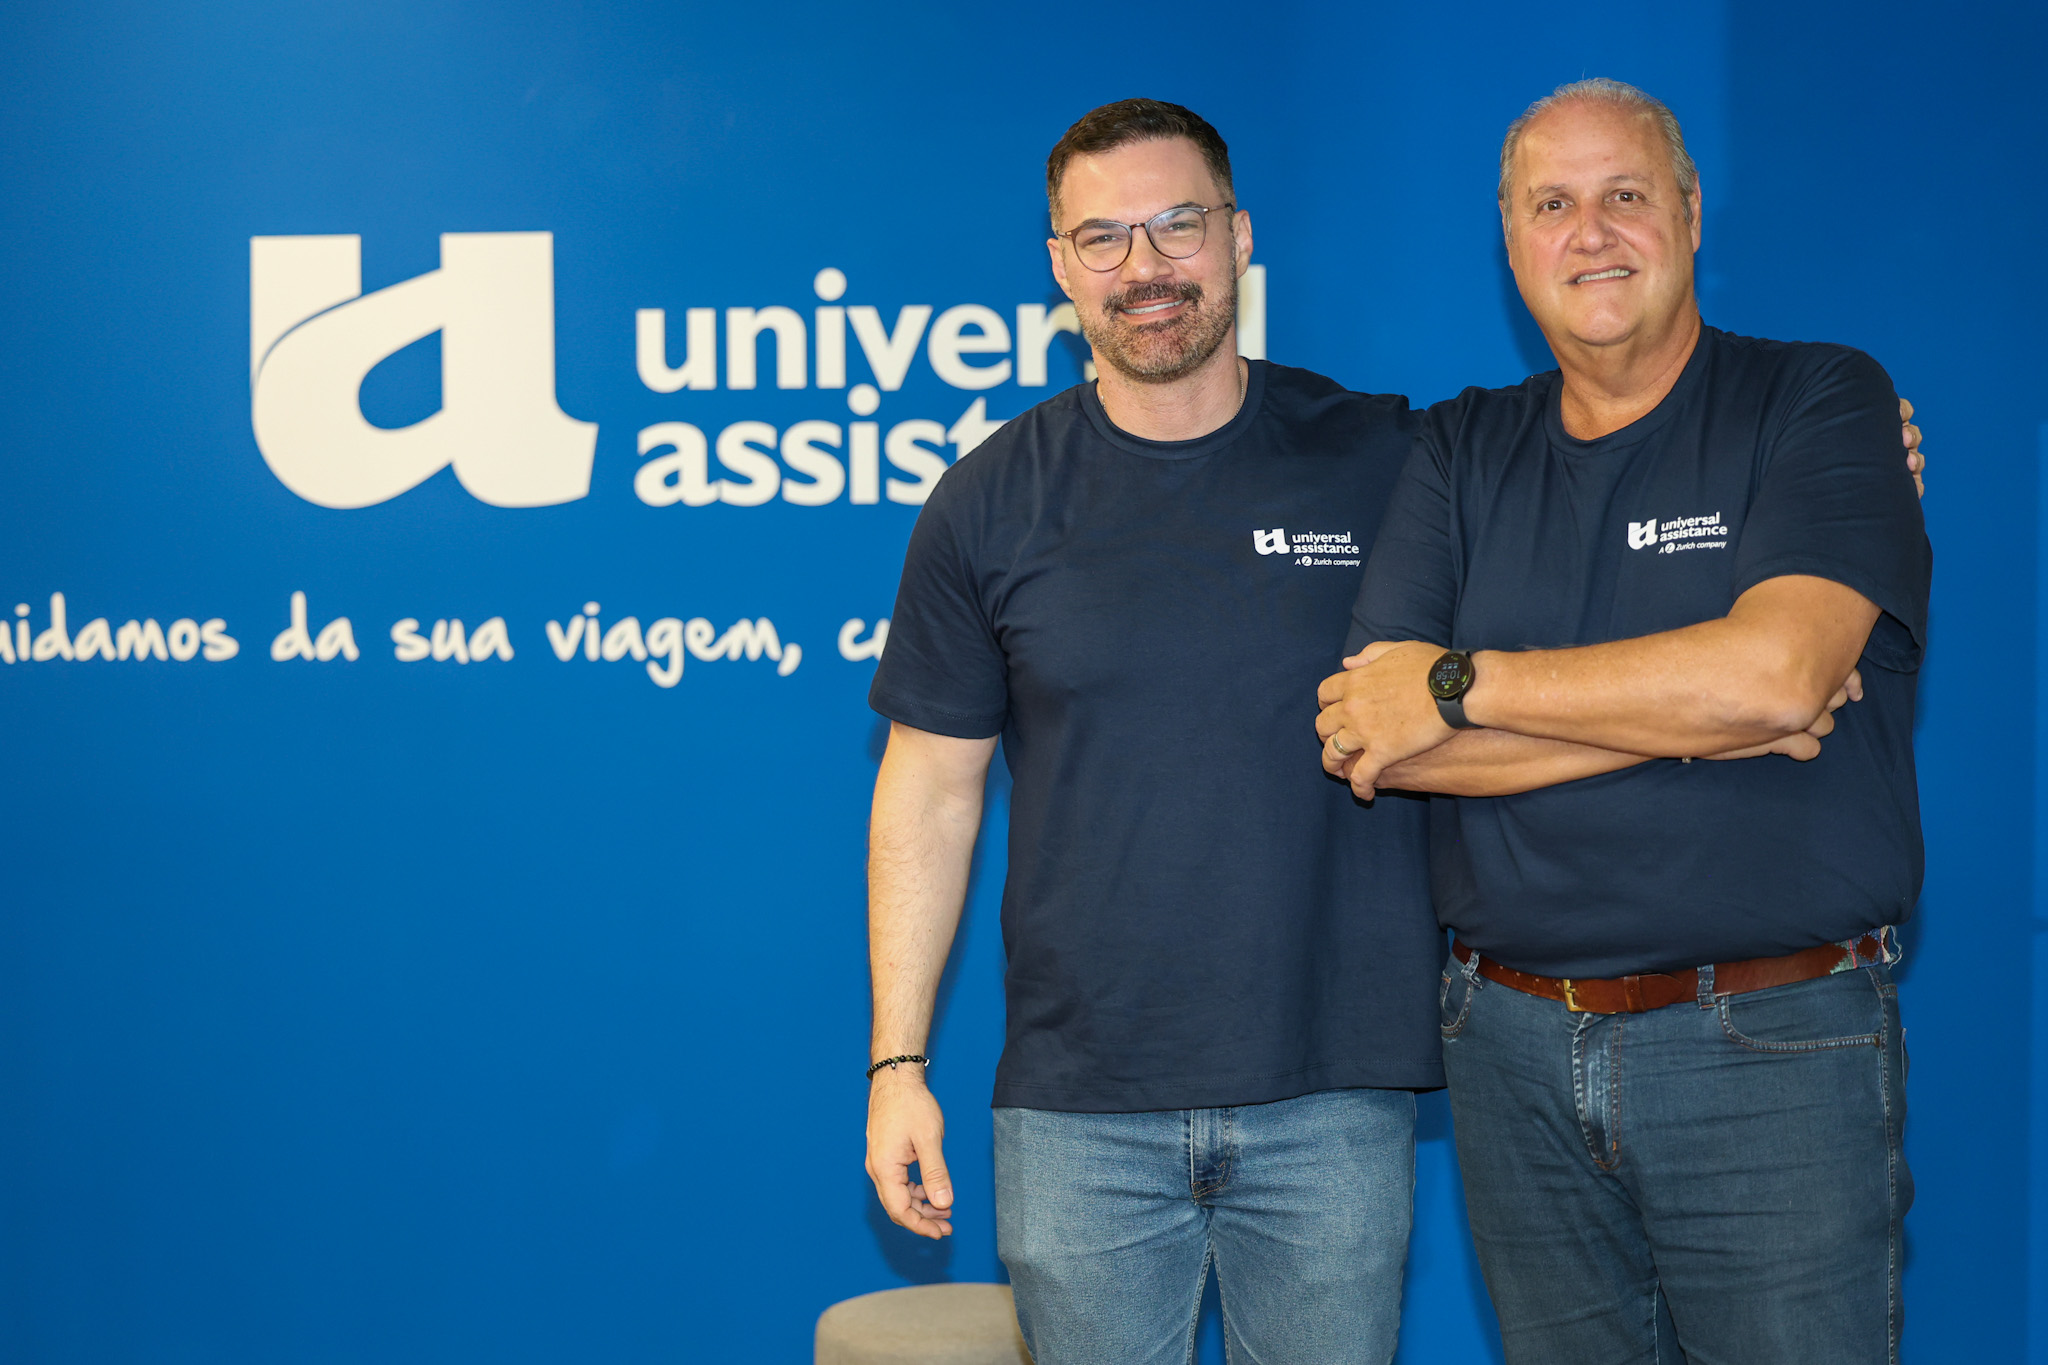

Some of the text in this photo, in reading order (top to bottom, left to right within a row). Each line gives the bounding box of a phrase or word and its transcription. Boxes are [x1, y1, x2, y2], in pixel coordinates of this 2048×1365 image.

[635, 264, 1267, 394] univerl
[1661, 511, 1720, 532] universal
[1292, 531, 1352, 543] universal
[1660, 525, 1728, 542] assistance
[1293, 541, 1360, 554] assistance
[1658, 546, 1664, 554] A
[1675, 542, 1696, 551] Zurich
[1696, 541, 1727, 549] company
[1313, 558, 1332, 566] Zurich
[1333, 559, 1361, 567] company
[271, 591, 360, 662] da
[391, 617, 514, 665] sua
[546, 602, 802, 688] viagem,
